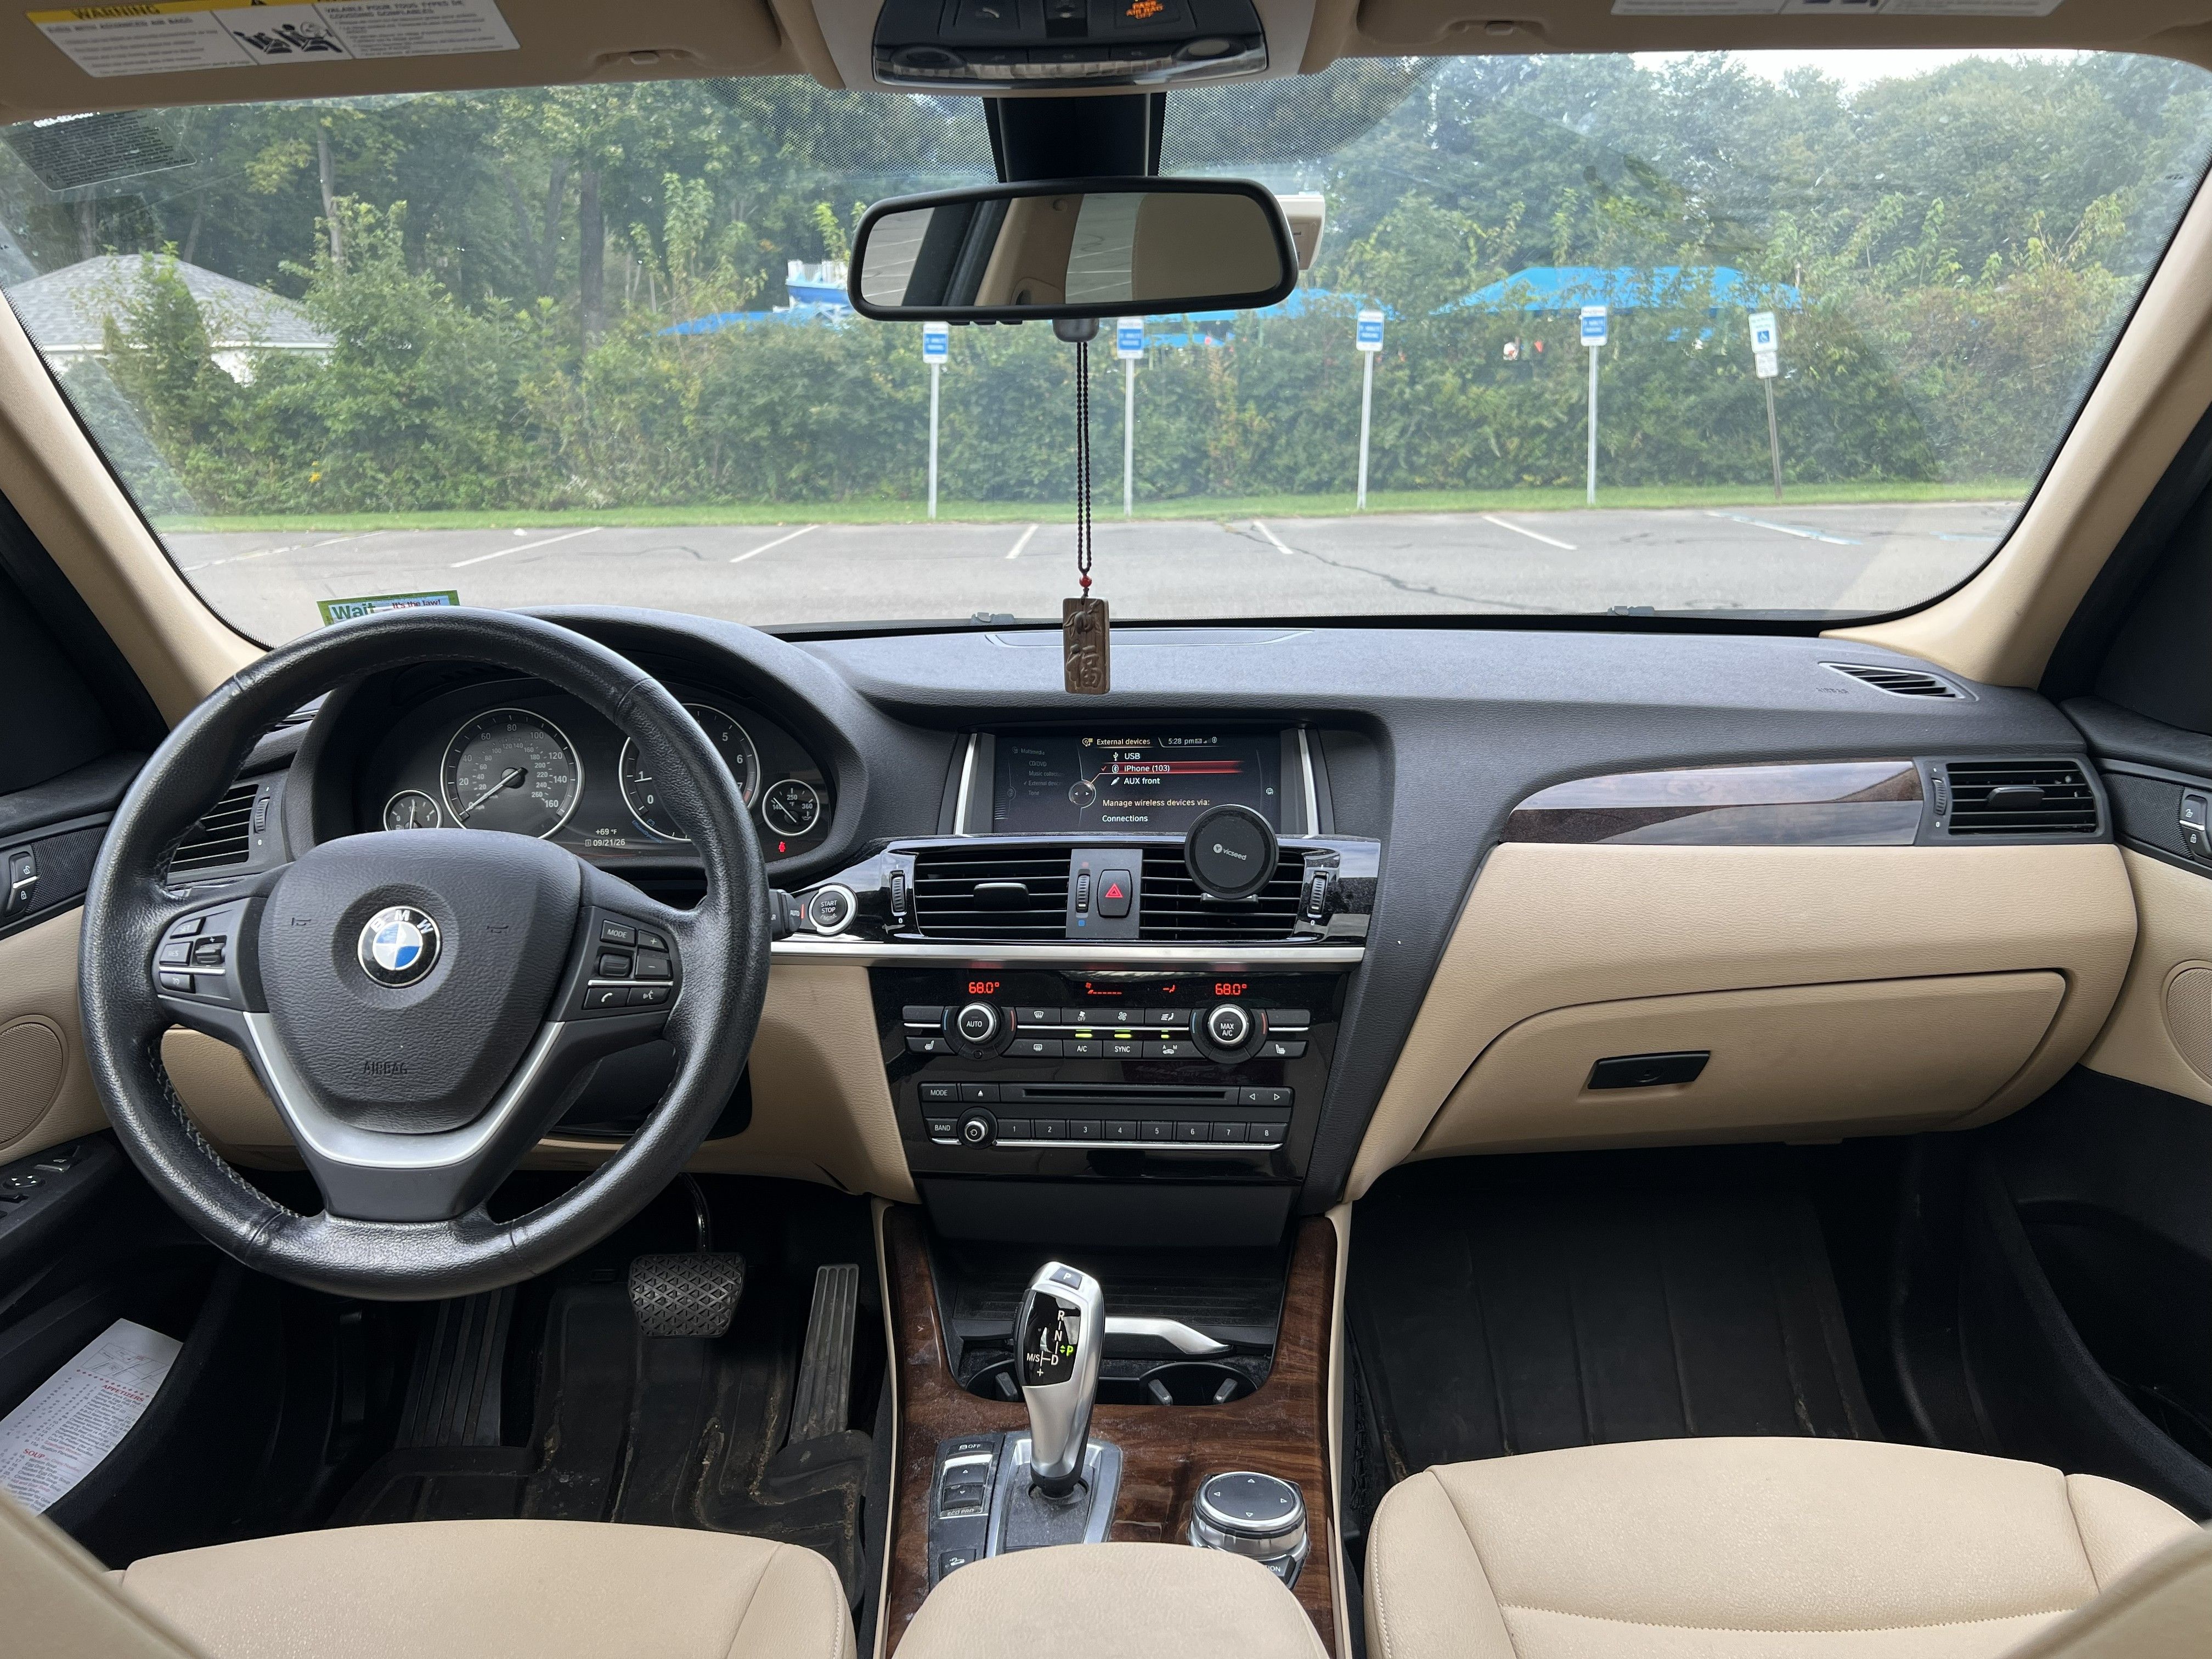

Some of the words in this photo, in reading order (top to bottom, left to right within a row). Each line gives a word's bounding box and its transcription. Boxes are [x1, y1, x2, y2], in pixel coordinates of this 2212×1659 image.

[332, 603, 375, 620] Wait
[530, 731, 544, 740] 100
[722, 732, 729, 741] 5
[549, 752, 563, 760] 120
[736, 754, 743, 764] 6
[639, 771, 644, 780] 1
[647, 794, 653, 804] 0
[1102, 799, 1133, 808] Manage
[592, 838, 626, 847] 09/21/26
[1223, 848, 1247, 861] vicseed
[820, 913, 838, 921] ENGINE
[607, 929, 628, 938] MODE
[363, 1061, 408, 1075] AIRBAG
[1057, 1310, 1065, 1321] R
[1054, 1330, 1063, 1341] N
[1066, 1345, 1074, 1356] P
[1026, 1352, 1040, 1363] M/S
[1051, 1354, 1059, 1365] D
[101, 1384, 145, 1402] APPETIZERS
[23, 1448, 46, 1459] SOUP
